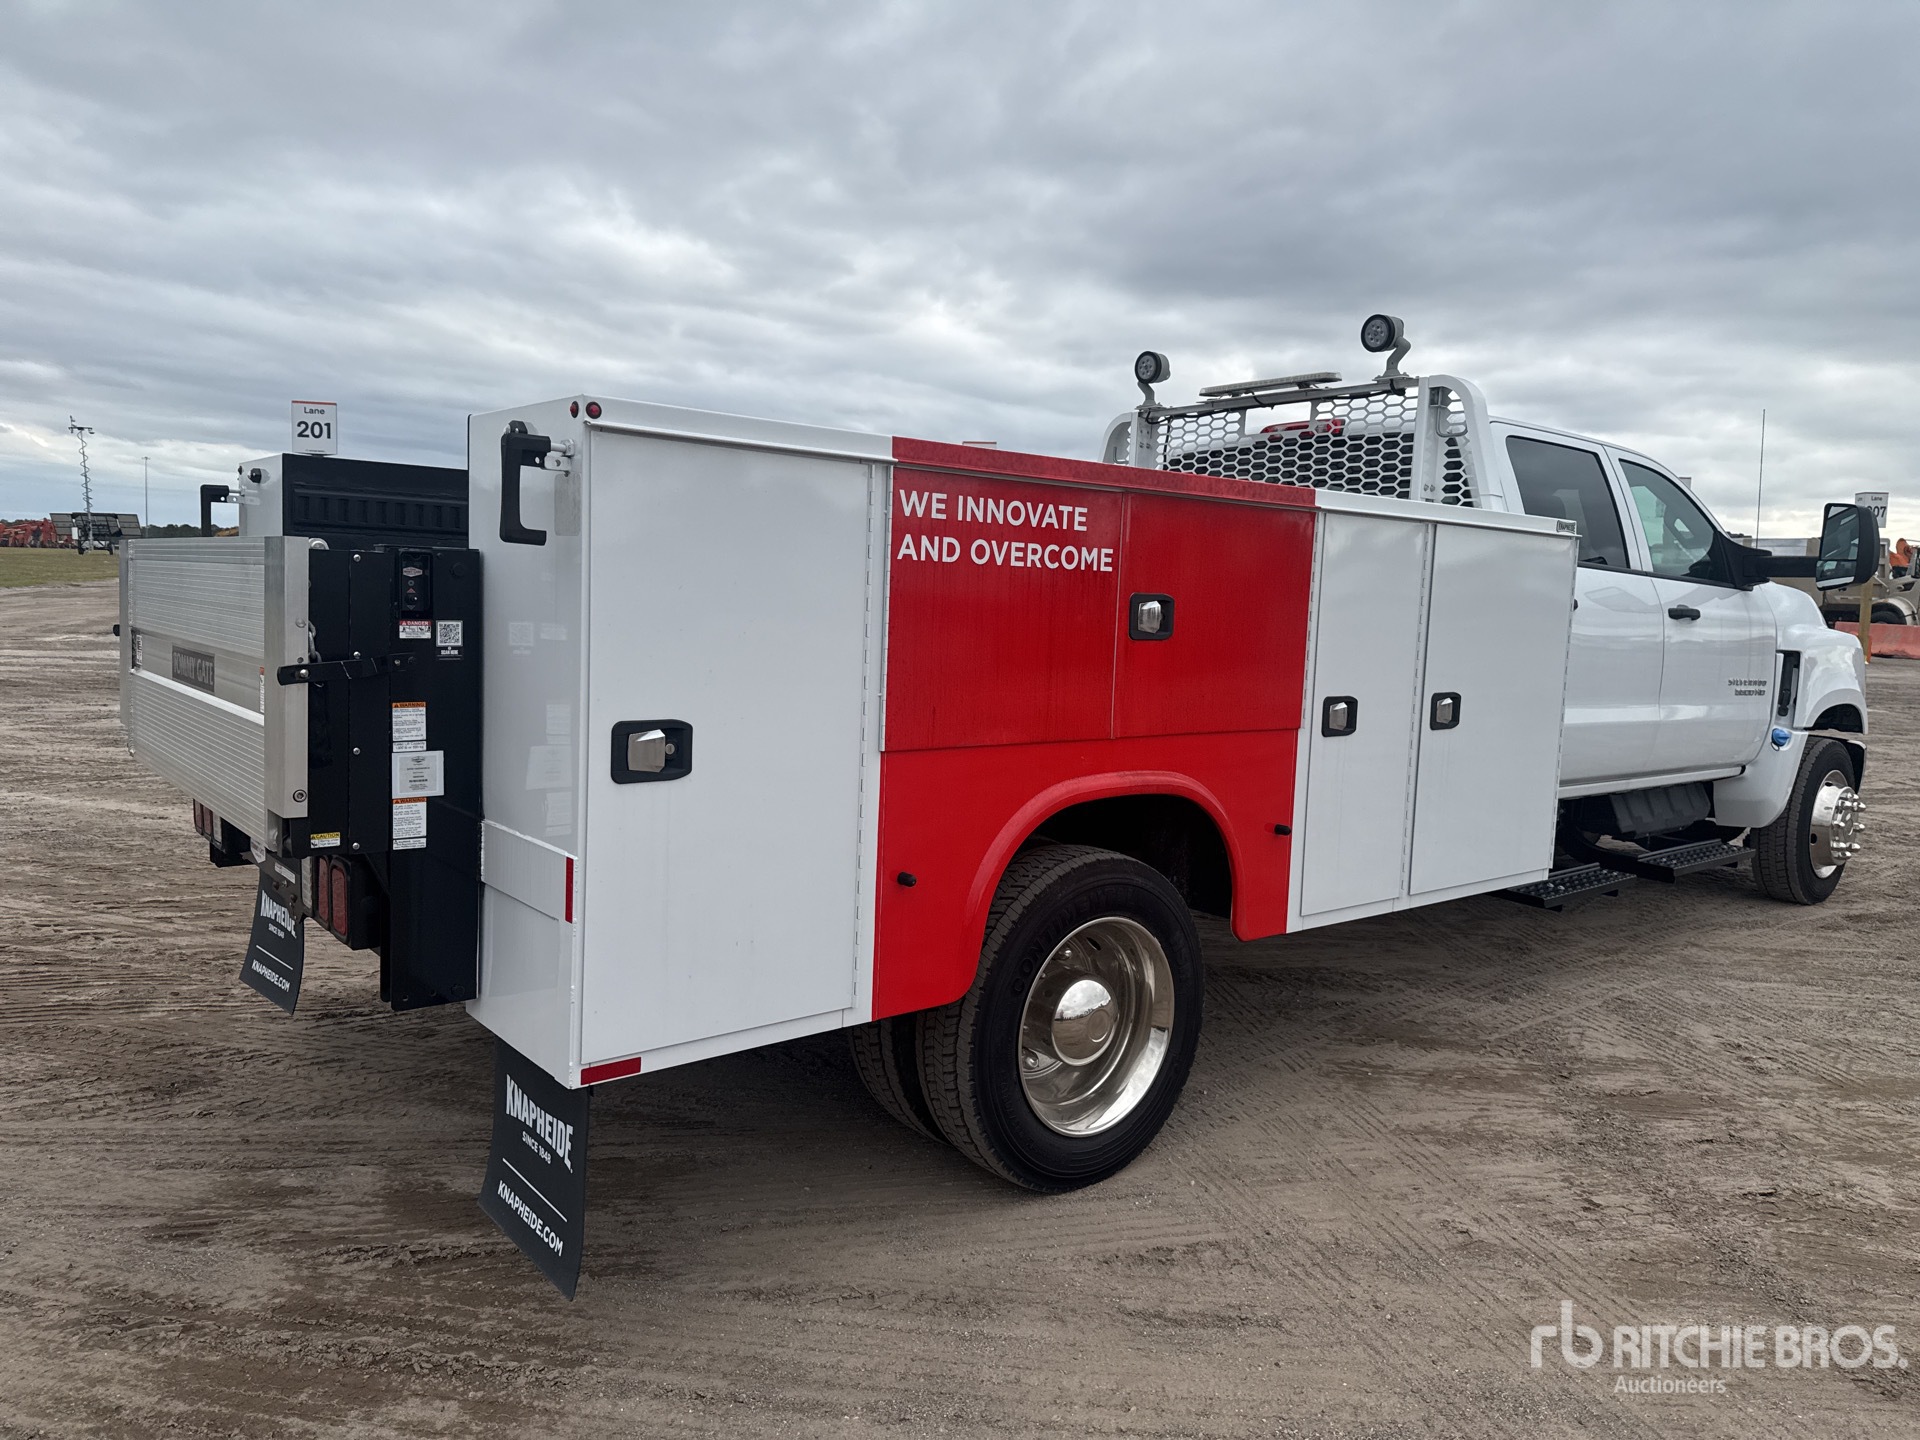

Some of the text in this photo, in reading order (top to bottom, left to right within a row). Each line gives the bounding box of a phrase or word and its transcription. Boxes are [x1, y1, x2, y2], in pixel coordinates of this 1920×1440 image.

[304, 406, 325, 415] Lane
[297, 421, 331, 439] 201
[899, 489, 1088, 531] WE INNOVATE
[897, 533, 1114, 572] AND OVERCOME
[197, 659, 214, 686] GATE
[260, 889, 297, 937] KNAPHEIDE
[268, 923, 278, 935] SINCE
[252, 959, 290, 993] KNAPHEIDE.COM
[506, 1073, 574, 1168] KNAPHEIDE
[522, 1131, 552, 1165] SINCE 1848
[497, 1180, 564, 1257] KNAPHEIDE.COM
